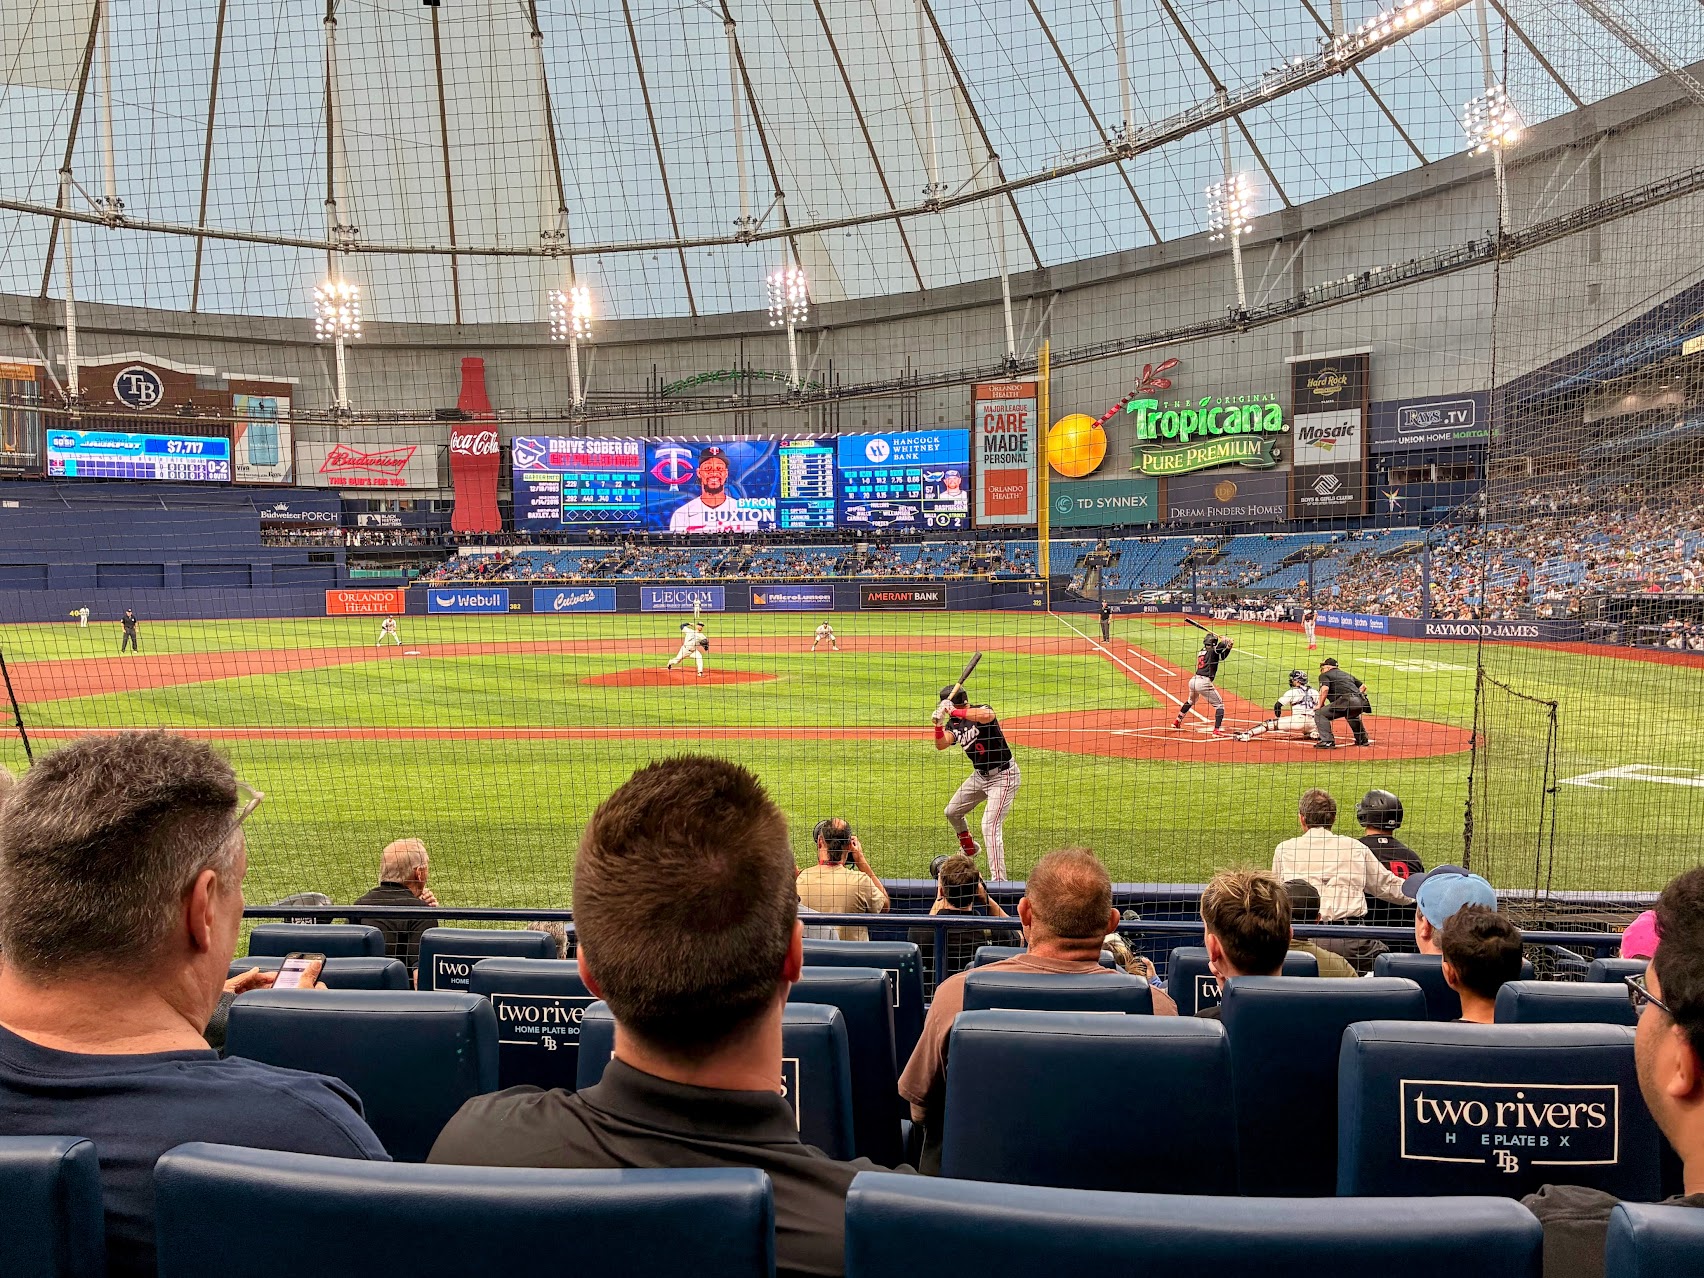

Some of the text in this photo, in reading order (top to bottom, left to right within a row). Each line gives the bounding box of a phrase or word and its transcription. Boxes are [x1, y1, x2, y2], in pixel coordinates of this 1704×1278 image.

[1307, 374, 1347, 387] Hard Rock
[122, 374, 156, 401] TB
[1217, 393, 1276, 404] ORIGINAL
[1005, 404, 1027, 412] LEAGUE
[984, 413, 1027, 433] CARE
[1127, 398, 1283, 442] Tropicana
[1299, 422, 1354, 440] Mosaic
[451, 430, 500, 455] Coca-Cola
[893, 436, 940, 445] HANCOCK
[984, 434, 1027, 452] MADE
[1399, 436, 1425, 444] UNION
[1427, 433, 1451, 442] HOME
[167, 440, 203, 454] $7,717
[550, 440, 638, 454] DRIVE SOBER OR
[893, 444, 940, 452] WHITNEY
[327, 451, 408, 466] Budweiser
[550, 453, 571, 466] GET
[573, 454, 612, 466] PULLED
[894, 452, 919, 460] BANK
[984, 453, 1028, 464] PERSONAL
[1142, 440, 1261, 470] PURE PREMIUM
[210, 462, 227, 472] 0-2
[738, 498, 776, 506] BYRON
[1077, 496, 1148, 509] TD SYNNEX
[261, 509, 338, 520] Budweiser PORCH
[708, 510, 775, 522] BUXTON
[1171, 505, 1283, 518] DREAM FINDERS HOMES
[338, 592, 394, 602] ORLANDO
[458, 594, 500, 606] Webull
[554, 589, 596, 610] Culver's
[652, 592, 712, 602] LECOM
[868, 592, 938, 600] AMERANT BANK
[345, 603, 388, 612] HEALTH
[1370, 620, 1384, 628] Spectrum
[1426, 623, 1538, 638] RAYMOND JAMES
[975, 744, 985, 755] 9
[439, 960, 469, 976] two
[1202, 981, 1222, 998] tw
[498, 1001, 585, 1024] two rive
[515, 1026, 540, 1034] HOME
[542, 1026, 566, 1034] PLATE
[541, 1036, 558, 1050] TB
[1414, 1091, 1606, 1128] two rivers
[1446, 1132, 1570, 1147] HE PLATE BX
[1493, 1150, 1519, 1174] TB
